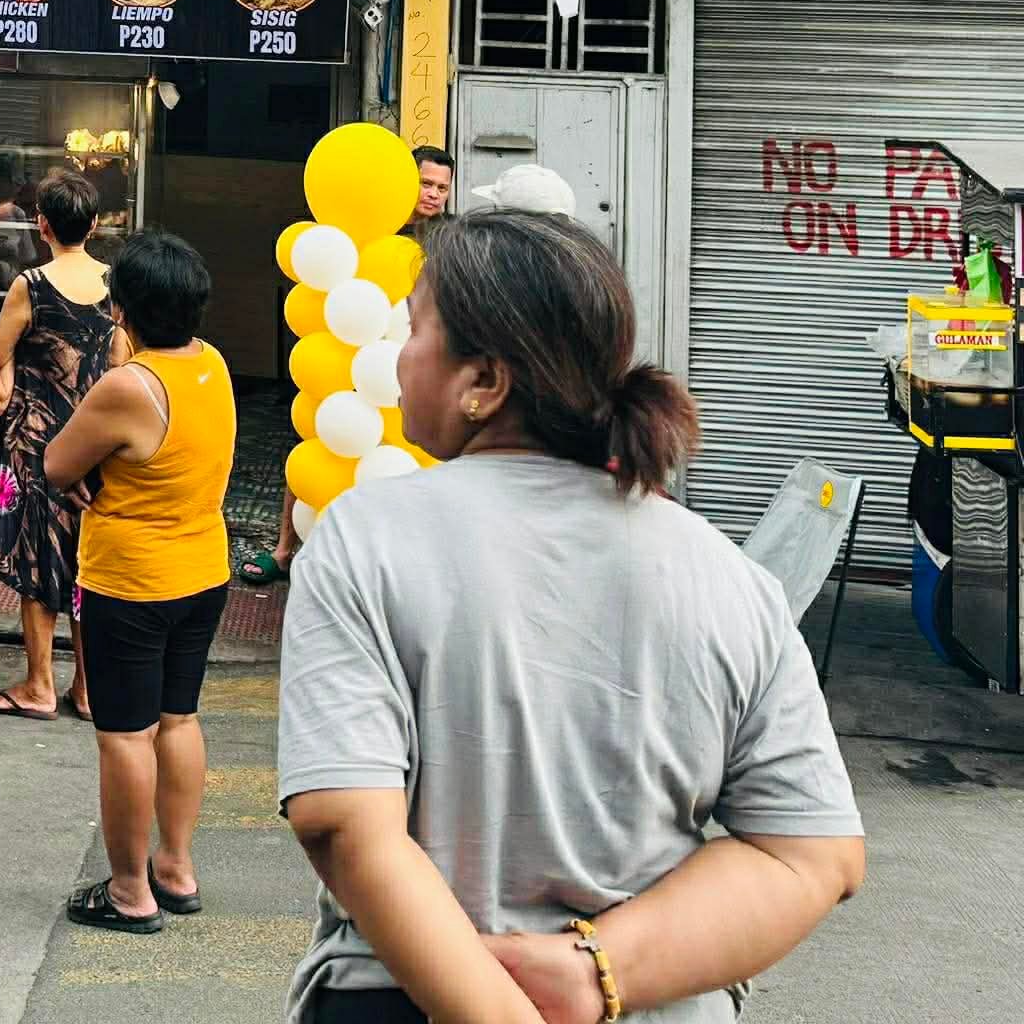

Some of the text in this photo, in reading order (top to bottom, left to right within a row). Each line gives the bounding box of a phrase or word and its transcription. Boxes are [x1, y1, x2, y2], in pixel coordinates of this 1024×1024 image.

[112, 5, 173, 22] LIEMPO
[250, 9, 297, 27] SISIG
[119, 24, 165, 49] P230
[249, 29, 297, 55] P250
[762, 138, 838, 193] NO
[783, 200, 859, 257] ON
[935, 333, 993, 346] GULAMAN
